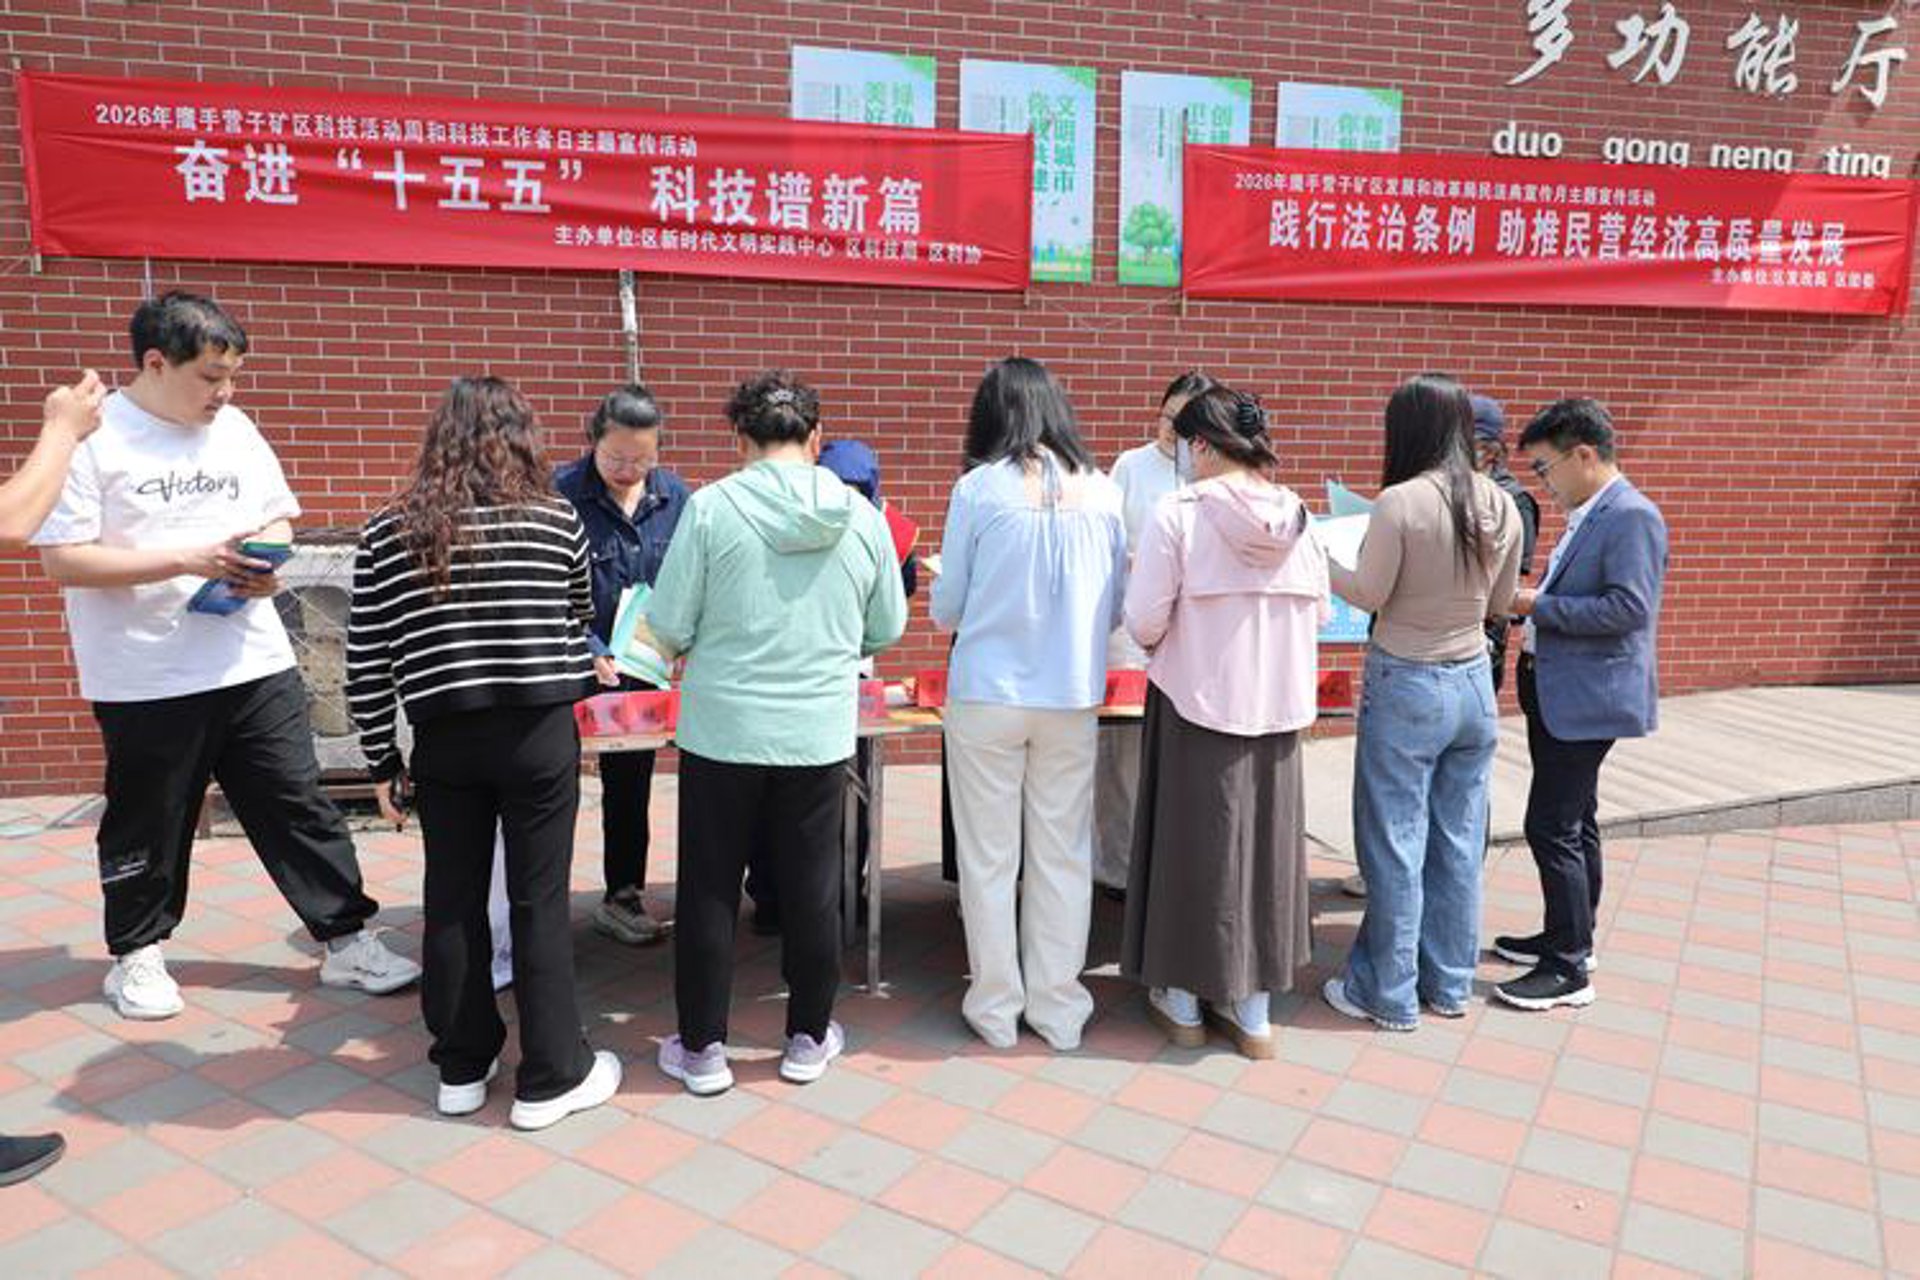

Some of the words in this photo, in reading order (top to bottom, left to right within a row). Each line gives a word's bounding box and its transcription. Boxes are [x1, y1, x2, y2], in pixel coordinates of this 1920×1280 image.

[1506, 0, 1908, 107] 多功能厅
[95, 103, 698, 158] 2026年鹰手营子矿区科技活动周和科技工作者日主题宣传活动
[1493, 121, 1563, 157] duo
[1603, 134, 1690, 167] gong
[1710, 142, 1793, 173] neng
[1825, 143, 1891, 178] ting
[650, 164, 924, 235] 科技谱新篇
[1269, 199, 1476, 254] 践行法治条例
[1496, 208, 1845, 267] 助推民营经济高质量发展
